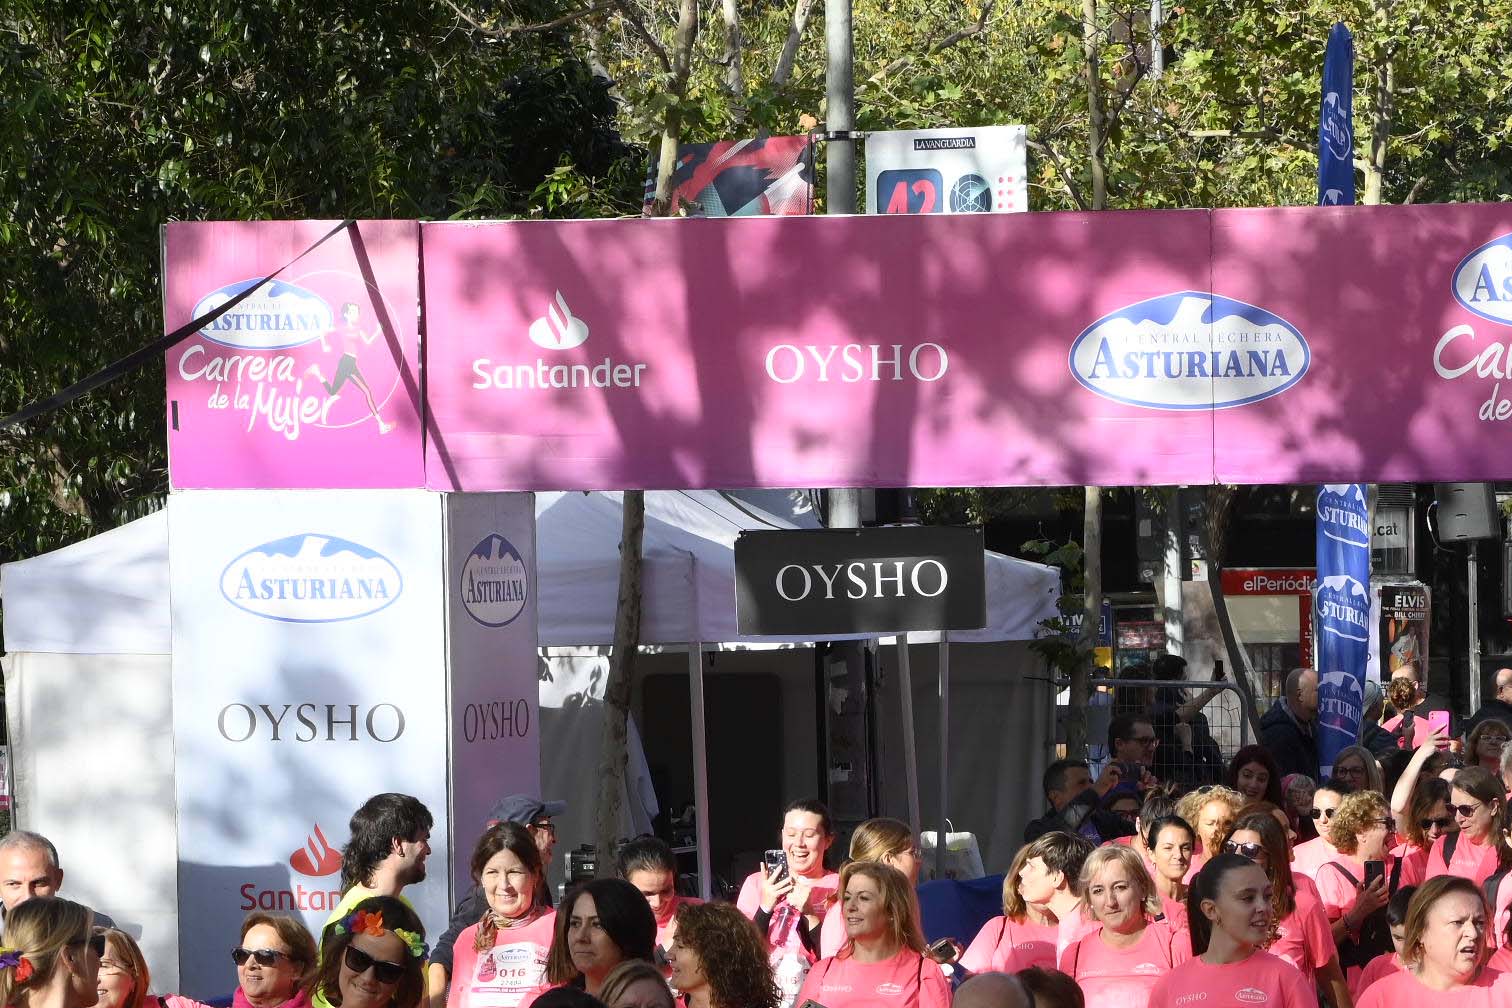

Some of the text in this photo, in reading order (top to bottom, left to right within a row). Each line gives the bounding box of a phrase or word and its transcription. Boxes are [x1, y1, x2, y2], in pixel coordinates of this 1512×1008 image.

[925, 138, 975, 150] VANGUARDIA
[178, 344, 296, 382] Carrera
[472, 358, 647, 391] Santander
[765, 342, 949, 385] OYSHO
[1088, 336, 1292, 380] ASTURIANA
[207, 379, 342, 441] de la Mujer
[234, 567, 389, 600] ASTURIANA
[466, 571, 524, 604] ASTURIANA
[775, 558, 949, 602] OYSHO
[1394, 595, 1426, 608] ELVIS
[217, 703, 406, 743] OYSHO
[463, 698, 530, 743] OYSHO
[499, 967, 527, 978] 016
[1175, 991, 1207, 1006] OYSHO
